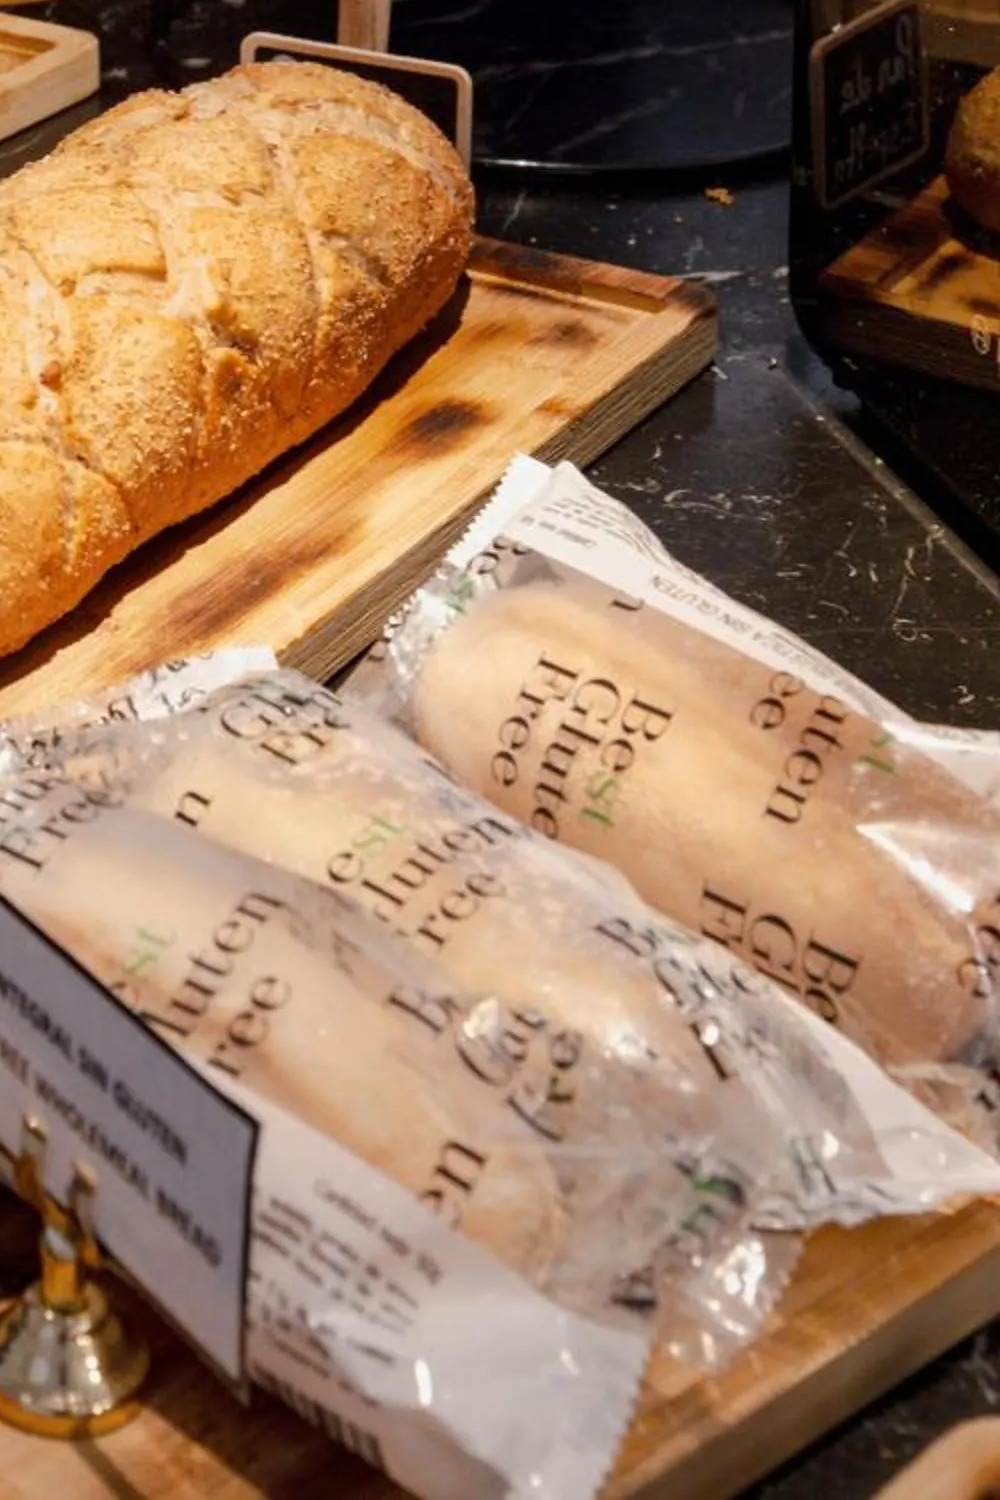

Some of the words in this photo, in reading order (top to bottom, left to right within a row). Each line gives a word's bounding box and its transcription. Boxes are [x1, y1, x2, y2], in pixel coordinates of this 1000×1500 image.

[491, 650, 578, 788] Free
[532, 677, 622, 840] Glute
[587, 690, 675, 829] Best
[749, 670, 805, 730] ee
[764, 694, 850, 827] uten
[327, 816, 403, 884] est
[361, 815, 516, 924] luten
[415, 873, 503, 948] ree
[140, 887, 283, 1042] luten
[208, 972, 292, 1079] ree
[77, 1045, 109, 1095] SIN
[112, 1077, 190, 1167] GLUTEN
[33, 1071, 150, 1202] WHOLEMEAL
[156, 1186, 222, 1271] BREAD
